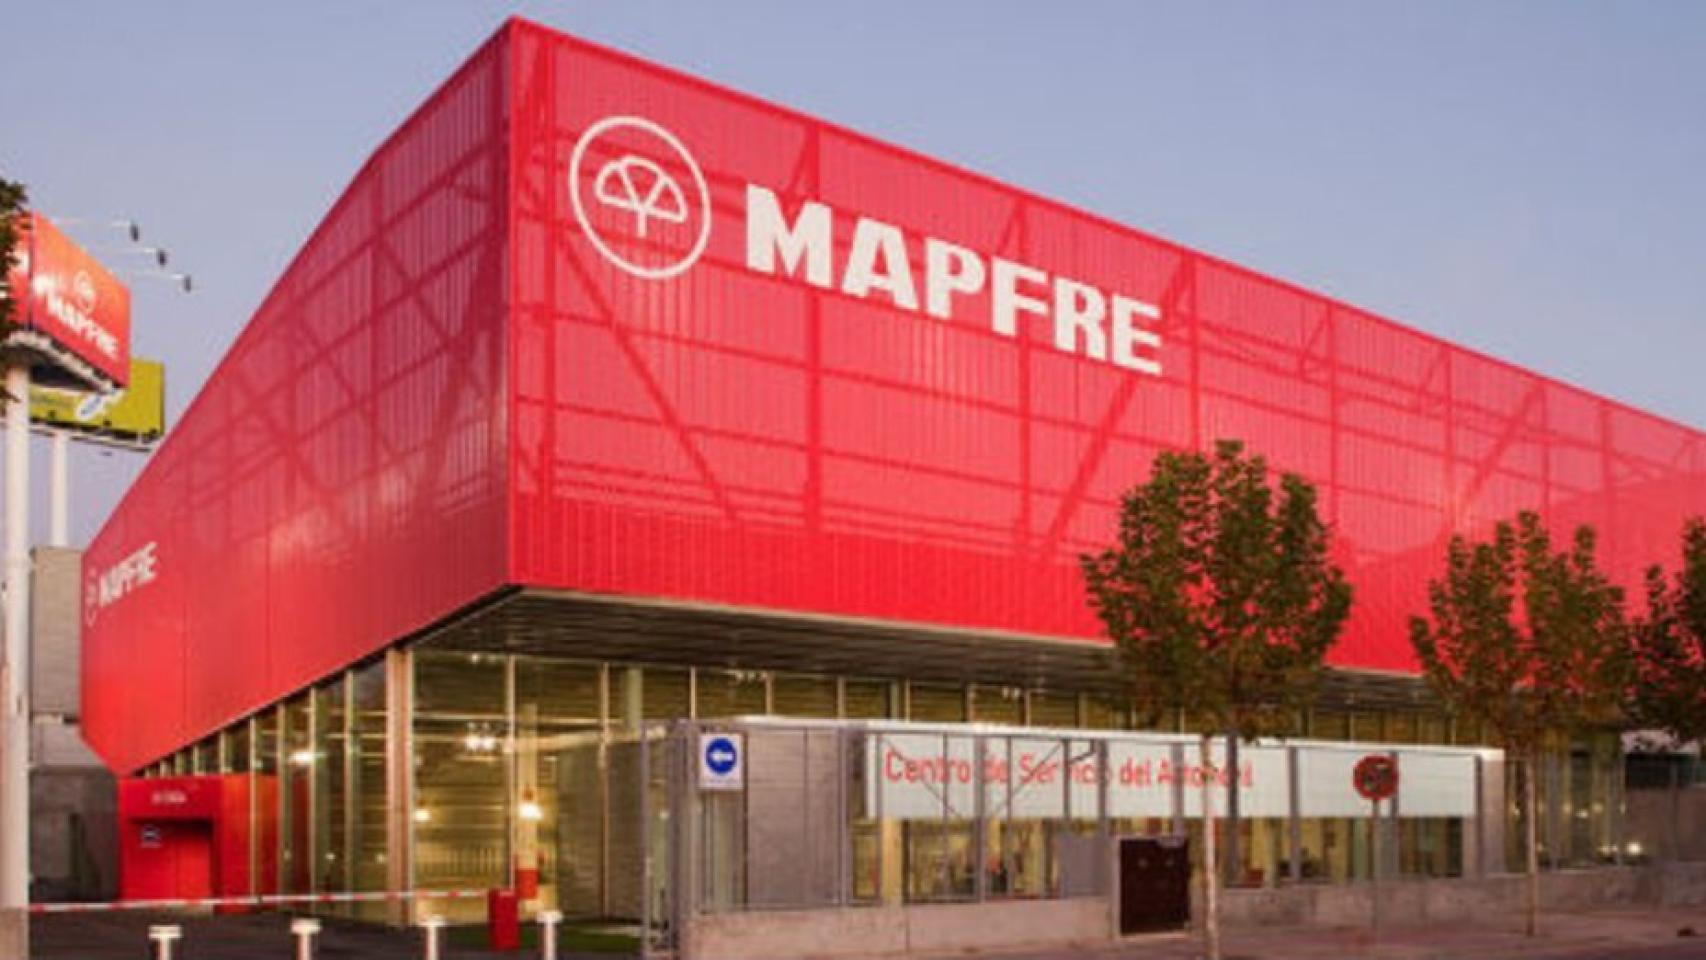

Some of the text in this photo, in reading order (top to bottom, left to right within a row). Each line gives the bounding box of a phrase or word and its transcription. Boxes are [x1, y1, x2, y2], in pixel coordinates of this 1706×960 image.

[746, 184, 1163, 376] MAPFRE
[98, 541, 158, 608] MAPFRE
[884, 747, 972, 784] Centro
[1118, 755, 1151, 788] del
